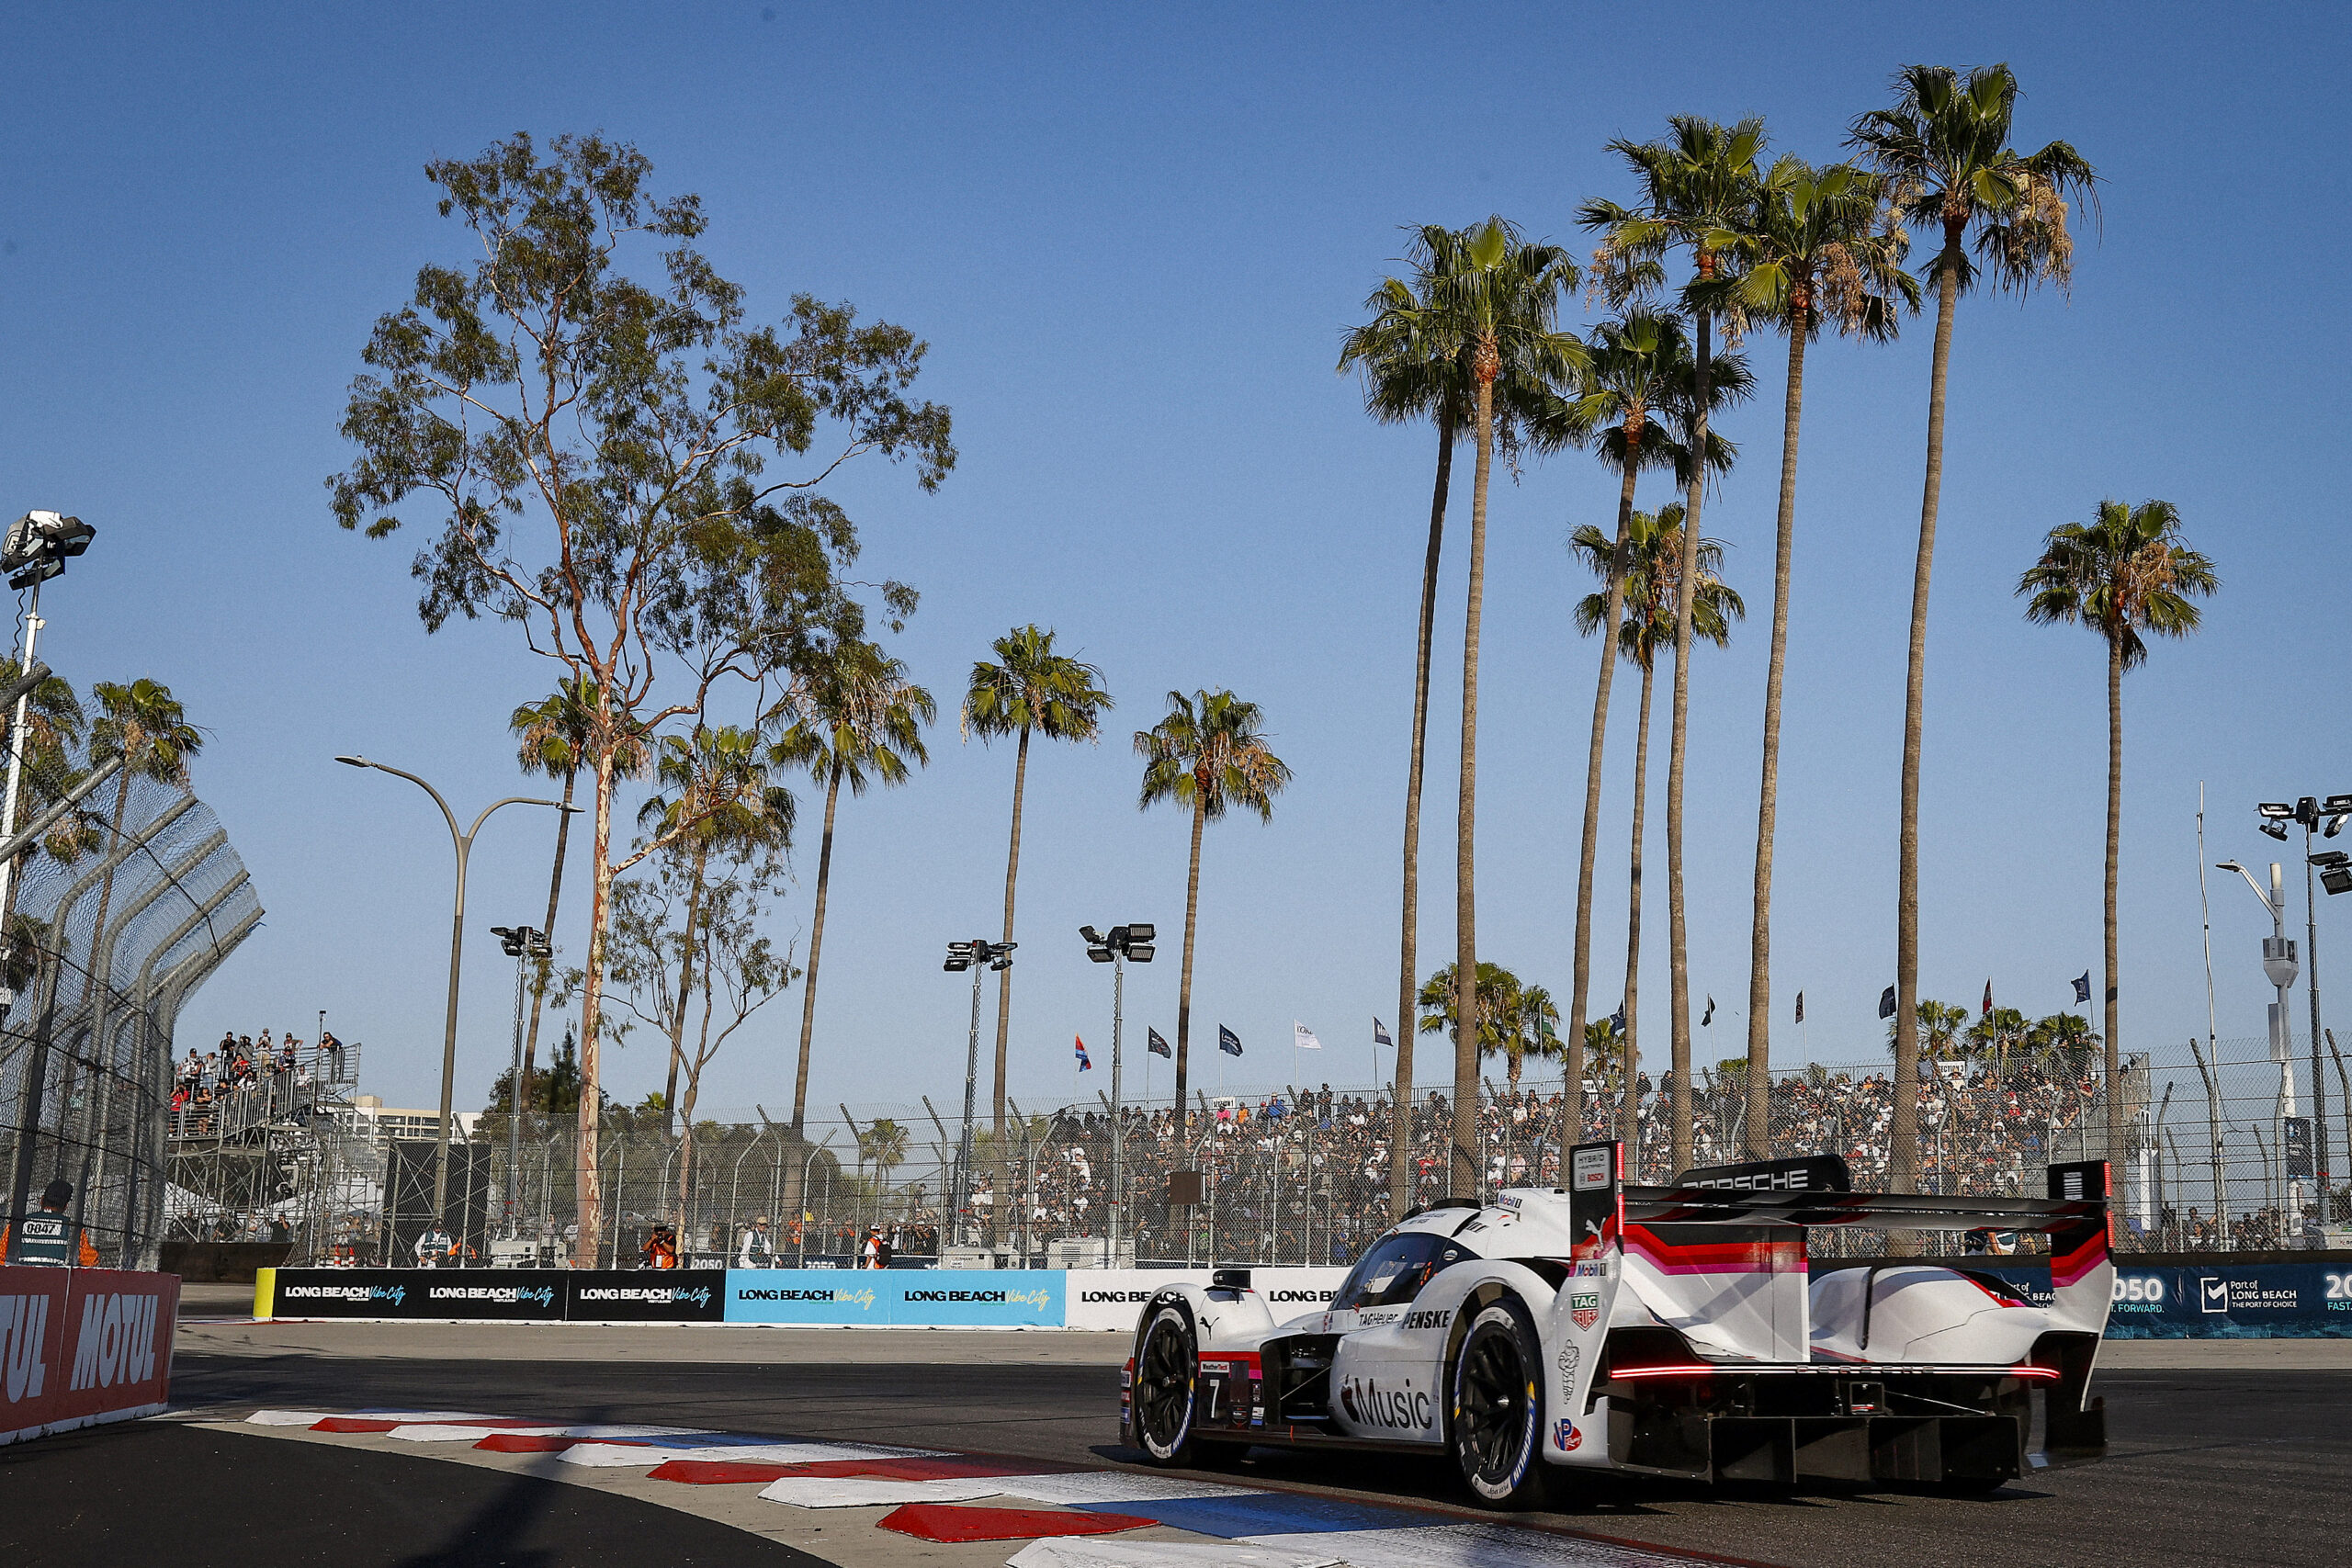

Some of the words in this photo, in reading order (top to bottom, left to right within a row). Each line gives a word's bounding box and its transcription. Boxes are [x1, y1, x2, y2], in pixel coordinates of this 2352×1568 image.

[1578, 1154, 1604, 1164] HYBRID
[1588, 1173, 1604, 1182] BOSCH
[1498, 1194, 1515, 1205] Mobil
[694, 1258, 723, 1269] 2050
[1577, 1265, 1599, 1277] Mobil
[1600, 1263, 1606, 1276] 1
[2021, 1281, 2030, 1292] of
[2230, 1280, 2247, 1290] Port
[2249, 1280, 2258, 1291] of
[285, 1286, 321, 1298] LONG
[322, 1287, 369, 1298] BEACH
[369, 1285, 387, 1300] Vibe
[386, 1284, 406, 1306] City
[429, 1288, 467, 1299] LONG
[468, 1288, 516, 1299] BEACH
[516, 1286, 535, 1301] Vibe
[534, 1285, 554, 1308] City
[580, 1288, 618, 1300] LONG
[620, 1288, 672, 1300] BEACH
[672, 1286, 690, 1302] Vibe
[690, 1285, 711, 1309] City
[738, 1289, 778, 1300] LONG
[781, 1290, 833, 1301] BEACH
[833, 1288, 854, 1303] Vibe
[854, 1287, 876, 1311] City
[904, 1290, 946, 1302] LONG
[949, 1291, 1005, 1302] BEACH
[1005, 1289, 1026, 1304] Vibe
[1027, 1288, 1050, 1312] City
[1081, 1291, 1125, 1303] LONG
[1270, 1291, 1317, 1303] LONG
[2231, 1290, 2259, 1300] LONG
[2262, 1290, 2298, 1300] BEACH
[1573, 1297, 1598, 1308] TAG
[2118, 1304, 2165, 1314] FORWARD.
[1401, 1310, 1451, 1330] PENSKE
[1572, 1310, 1599, 1327] HEUER
[70, 1292, 159, 1391] MOTUL
[1209, 1379, 1220, 1419] 7
[1355, 1378, 1432, 1430] Music
